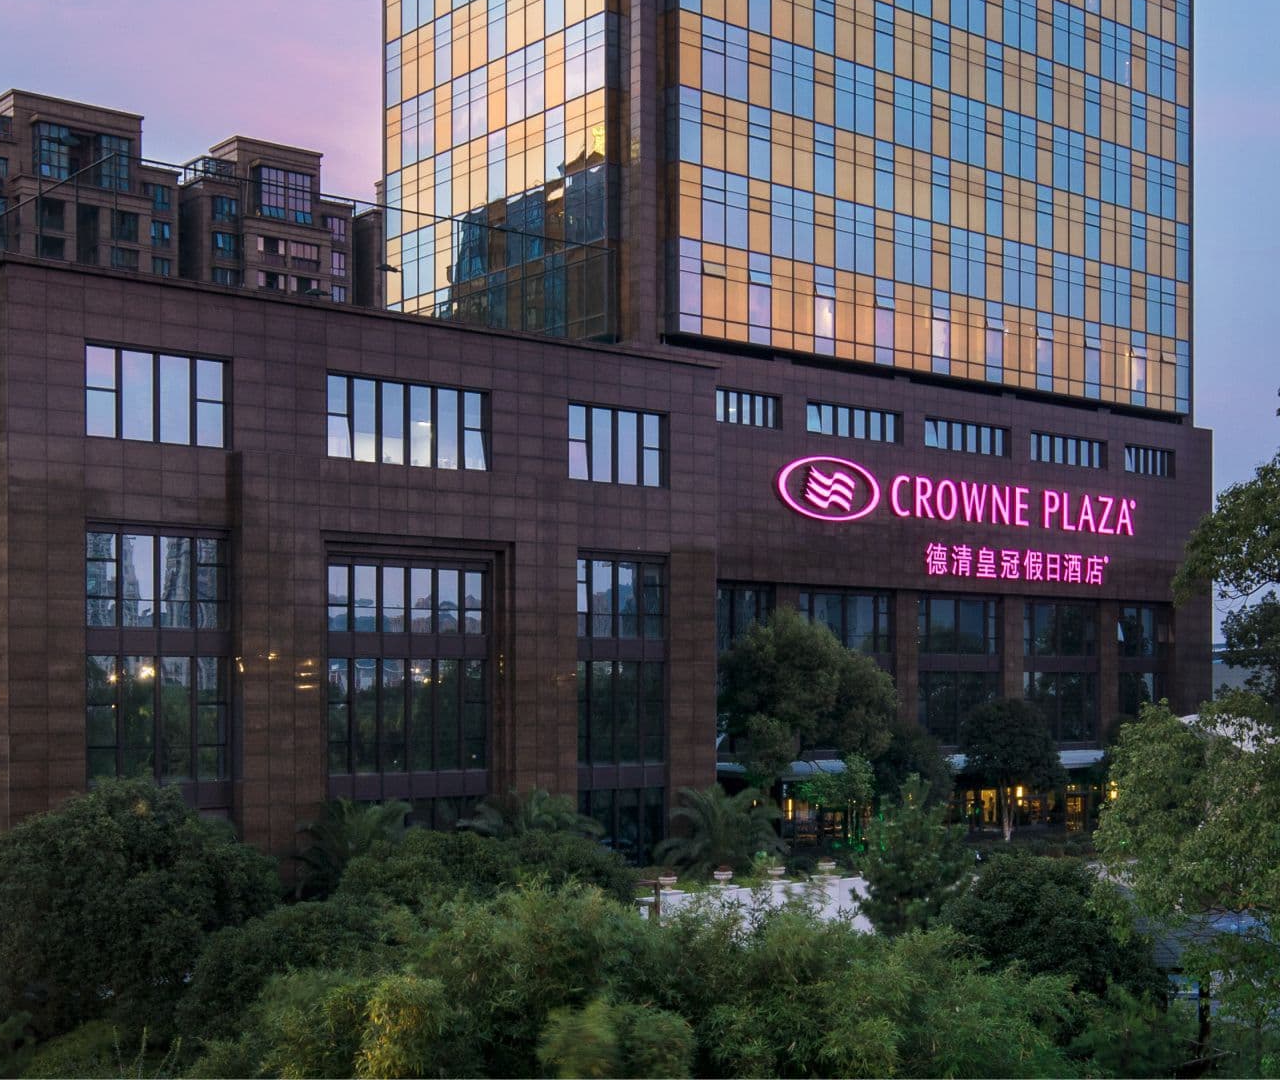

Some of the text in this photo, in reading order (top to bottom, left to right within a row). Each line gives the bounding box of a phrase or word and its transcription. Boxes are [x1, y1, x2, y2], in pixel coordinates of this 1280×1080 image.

[891, 475, 1135, 536] CROWNE PLAZA
[926, 542, 1104, 585] 德清皇冠假日酒店
